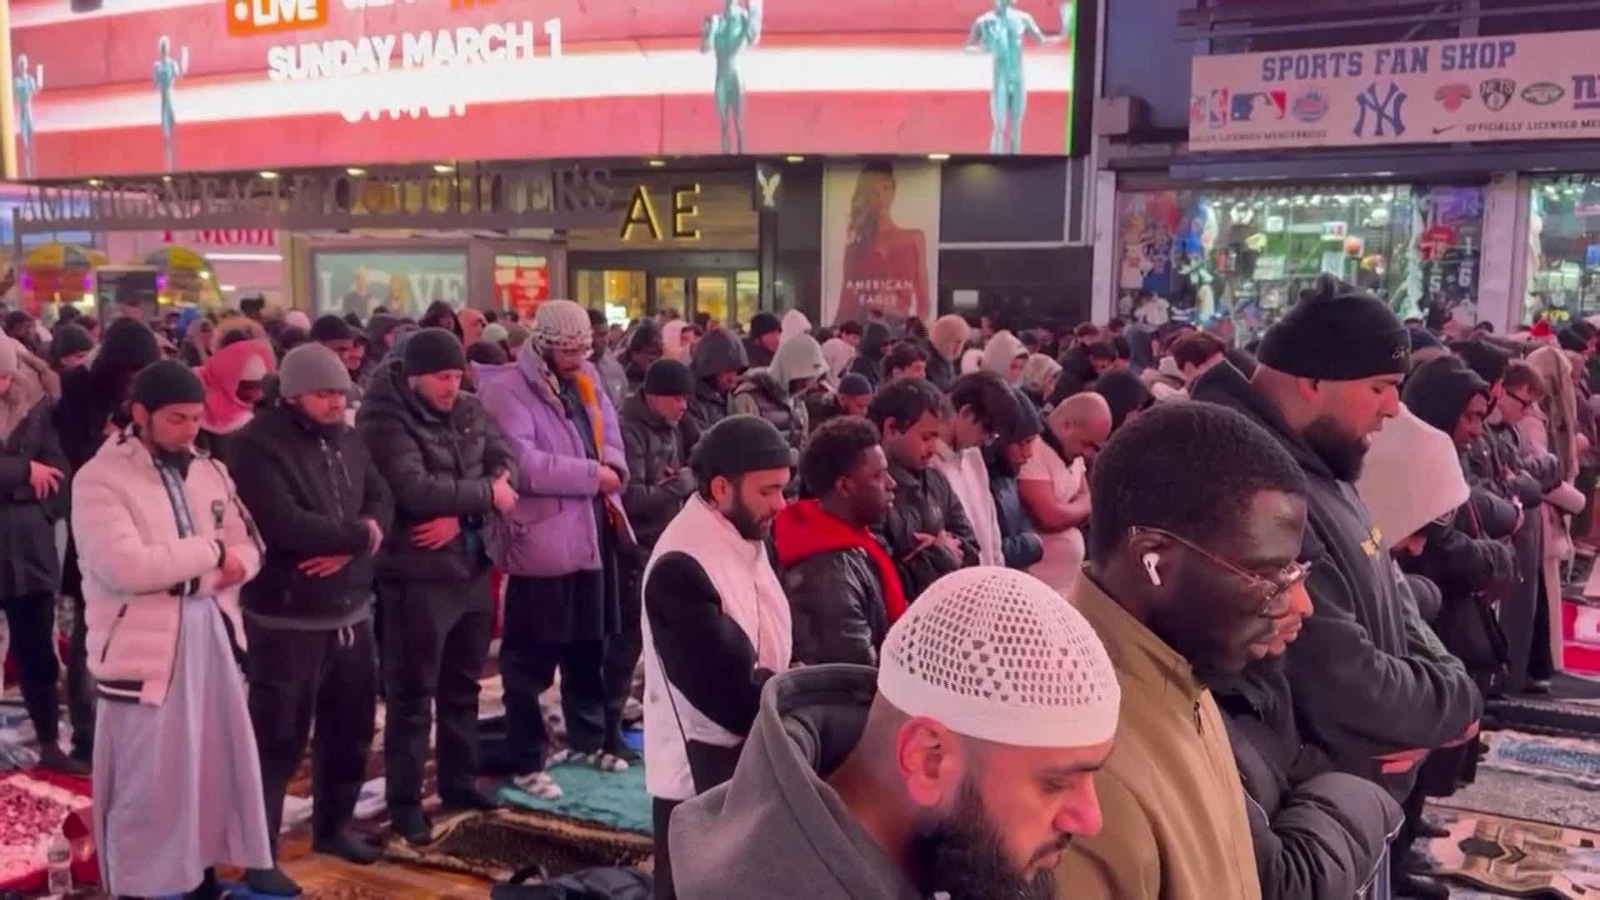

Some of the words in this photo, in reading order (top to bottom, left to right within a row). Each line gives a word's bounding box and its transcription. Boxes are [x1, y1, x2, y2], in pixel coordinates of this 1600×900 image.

[253, 0, 318, 26] LIVE
[267, 36, 395, 81] SUNDAY
[402, 21, 534, 67] MARCH
[543, 18, 563, 57] 1
[1262, 51, 1363, 81] SPORTS
[1374, 47, 1429, 75] FAN
[1441, 41, 1516, 71] SHOP
[1465, 122, 1522, 132] OFFICIALLY
[1527, 120, 1577, 131] LICENSED
[620, 184, 701, 241] AE
[845, 279, 914, 291] AMERICAN
